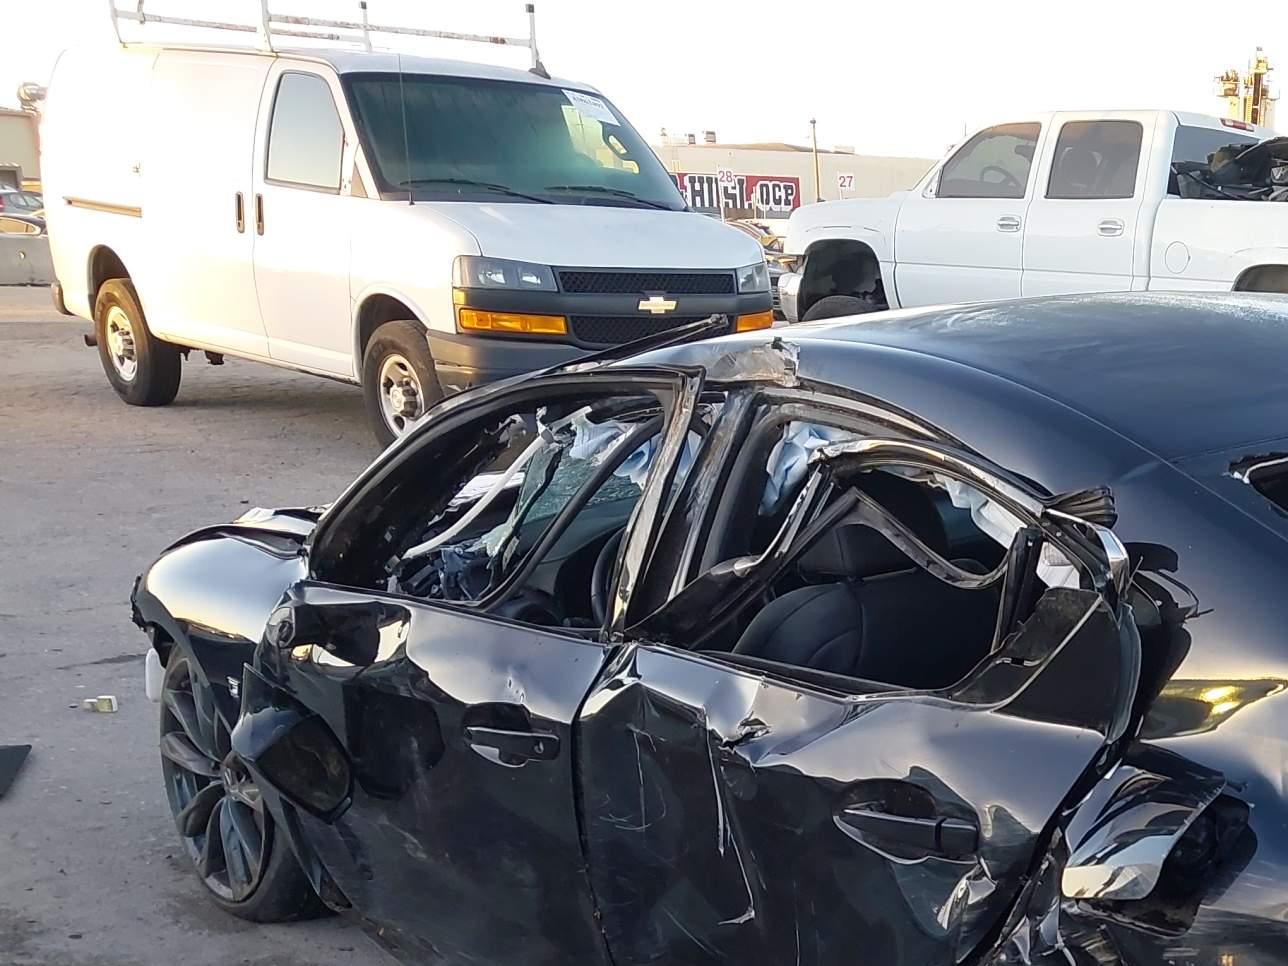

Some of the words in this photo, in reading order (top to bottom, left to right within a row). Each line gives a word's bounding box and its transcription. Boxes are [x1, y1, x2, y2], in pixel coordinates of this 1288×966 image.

[718, 170, 733, 183] 28
[838, 175, 854, 188] 27
[759, 183, 794, 207] OCP
